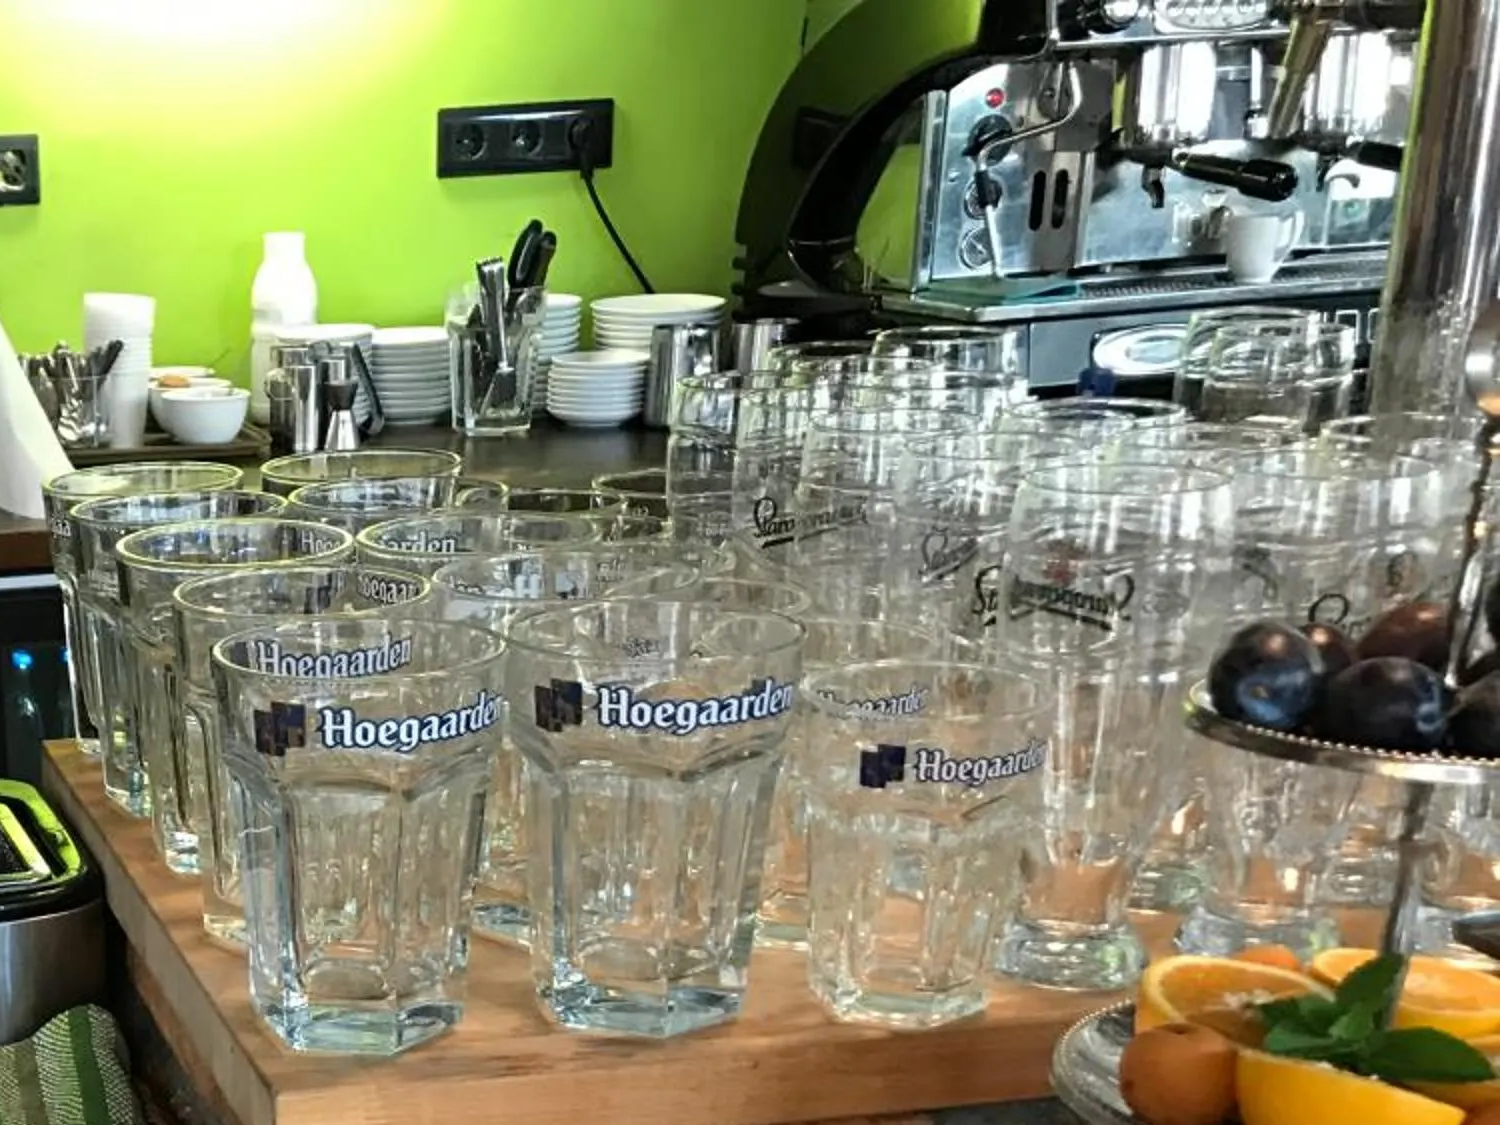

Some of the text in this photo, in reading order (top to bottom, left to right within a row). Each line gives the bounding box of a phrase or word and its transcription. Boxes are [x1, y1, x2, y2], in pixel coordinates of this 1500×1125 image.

[320, 690, 502, 753] Hoegaarde
[597, 676, 794, 735] Hoegaarden
[914, 738, 1048, 787] Hoegaarde
